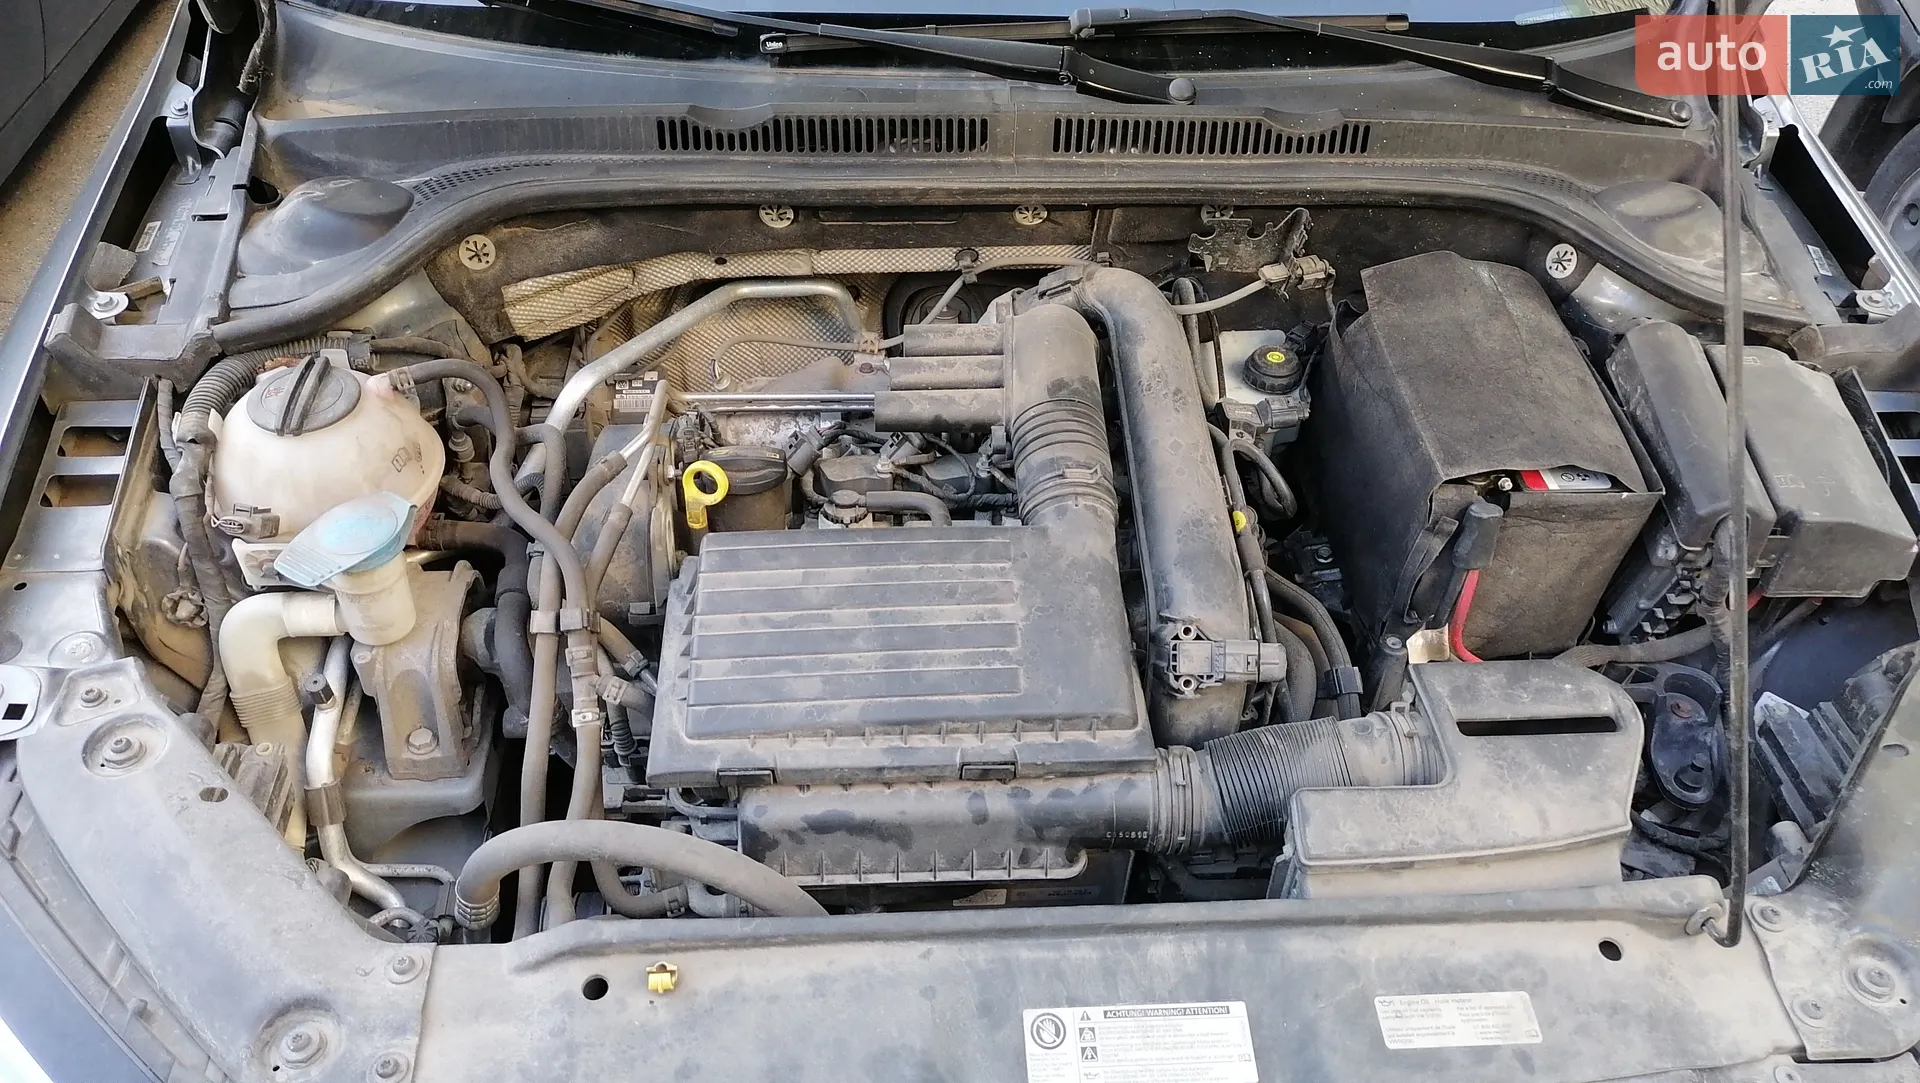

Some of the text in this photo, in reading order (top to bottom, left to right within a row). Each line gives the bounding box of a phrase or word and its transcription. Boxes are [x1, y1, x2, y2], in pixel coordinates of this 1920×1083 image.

[1106, 1006, 1228, 1018] ACHTUNG! WARNING! ATTENTION!
